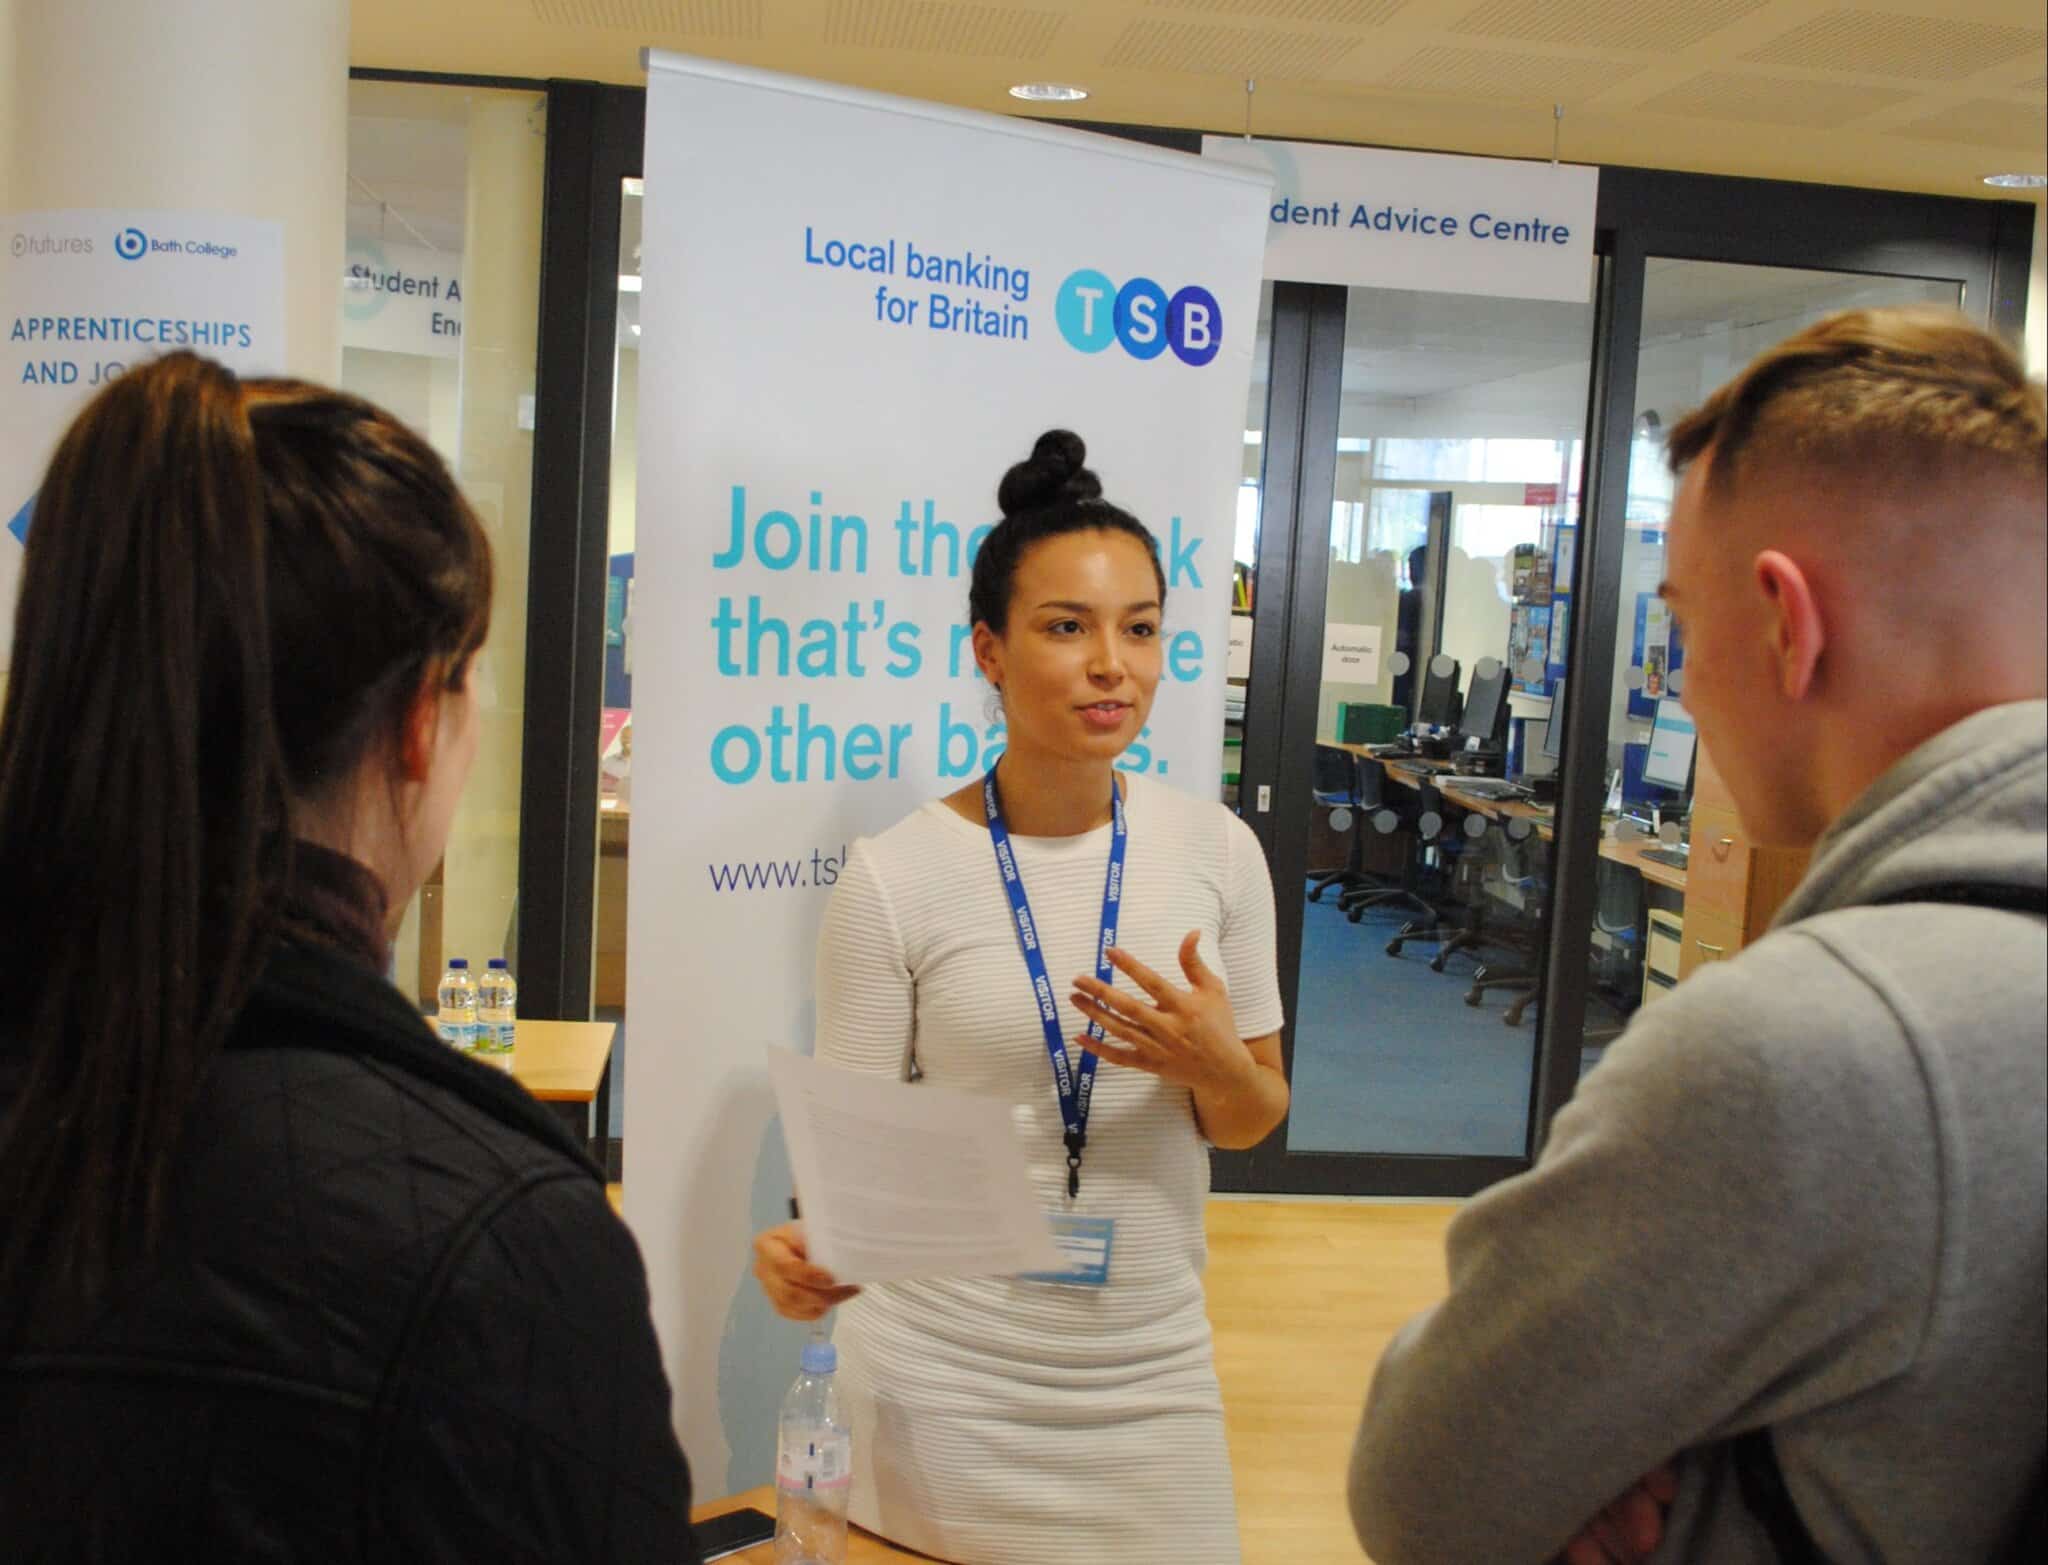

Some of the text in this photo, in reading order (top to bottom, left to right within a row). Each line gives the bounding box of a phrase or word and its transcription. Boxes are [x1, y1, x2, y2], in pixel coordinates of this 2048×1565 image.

[1349, 204, 1457, 237] Advice
[1469, 213, 1570, 245] Centre
[151, 238, 238, 260] Bath College
[805, 227, 1030, 301] Local banking
[10, 317, 252, 348] APPRENTICESHIPS
[875, 286, 1029, 340] for Britain
[1074, 285, 1212, 351] TSB
[22, 361, 78, 385] AND
[712, 485, 869, 575] Join
[709, 703, 912, 785] other
[996, 840, 1016, 881] VISITOR
[1108, 862, 1120, 902] VISITOR
[1017, 906, 1036, 950] VISITOR
[1035, 975, 1054, 1021] VISITOR
[1054, 1049, 1072, 1096] VISITOR
